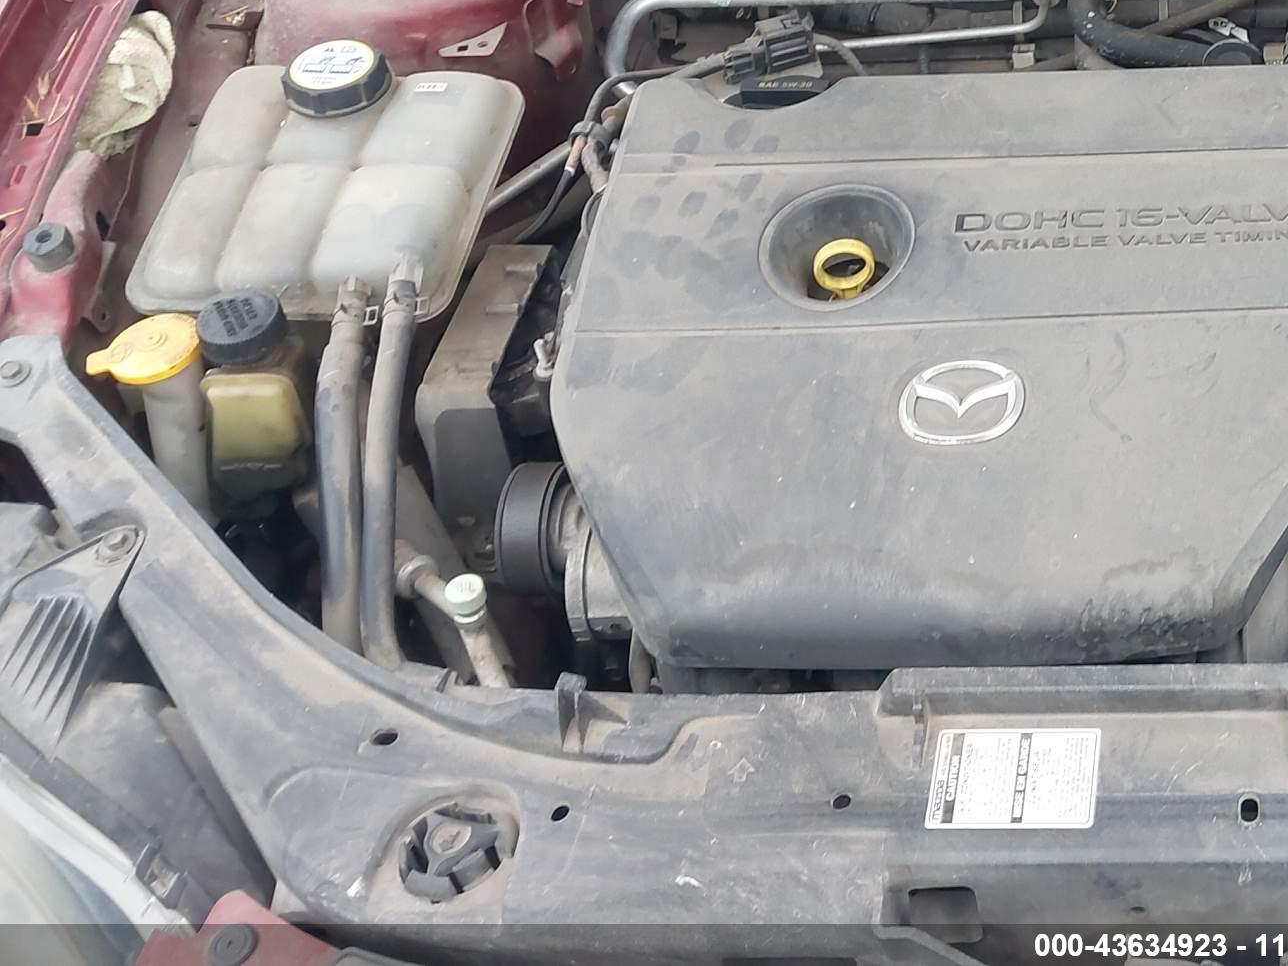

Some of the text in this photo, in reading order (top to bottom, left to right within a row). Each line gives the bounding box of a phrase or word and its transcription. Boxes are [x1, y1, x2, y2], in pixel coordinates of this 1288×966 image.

[954, 209, 1105, 233] DOHC
[963, 234, 1108, 252] VARIABLE
[1119, 231, 1207, 247] VALVE
[1017, 737, 1031, 775] GARDE
[946, 754, 961, 802] CAUTION
[1015, 775, 1027, 791] EN
[931, 780, 945, 821] mazda
